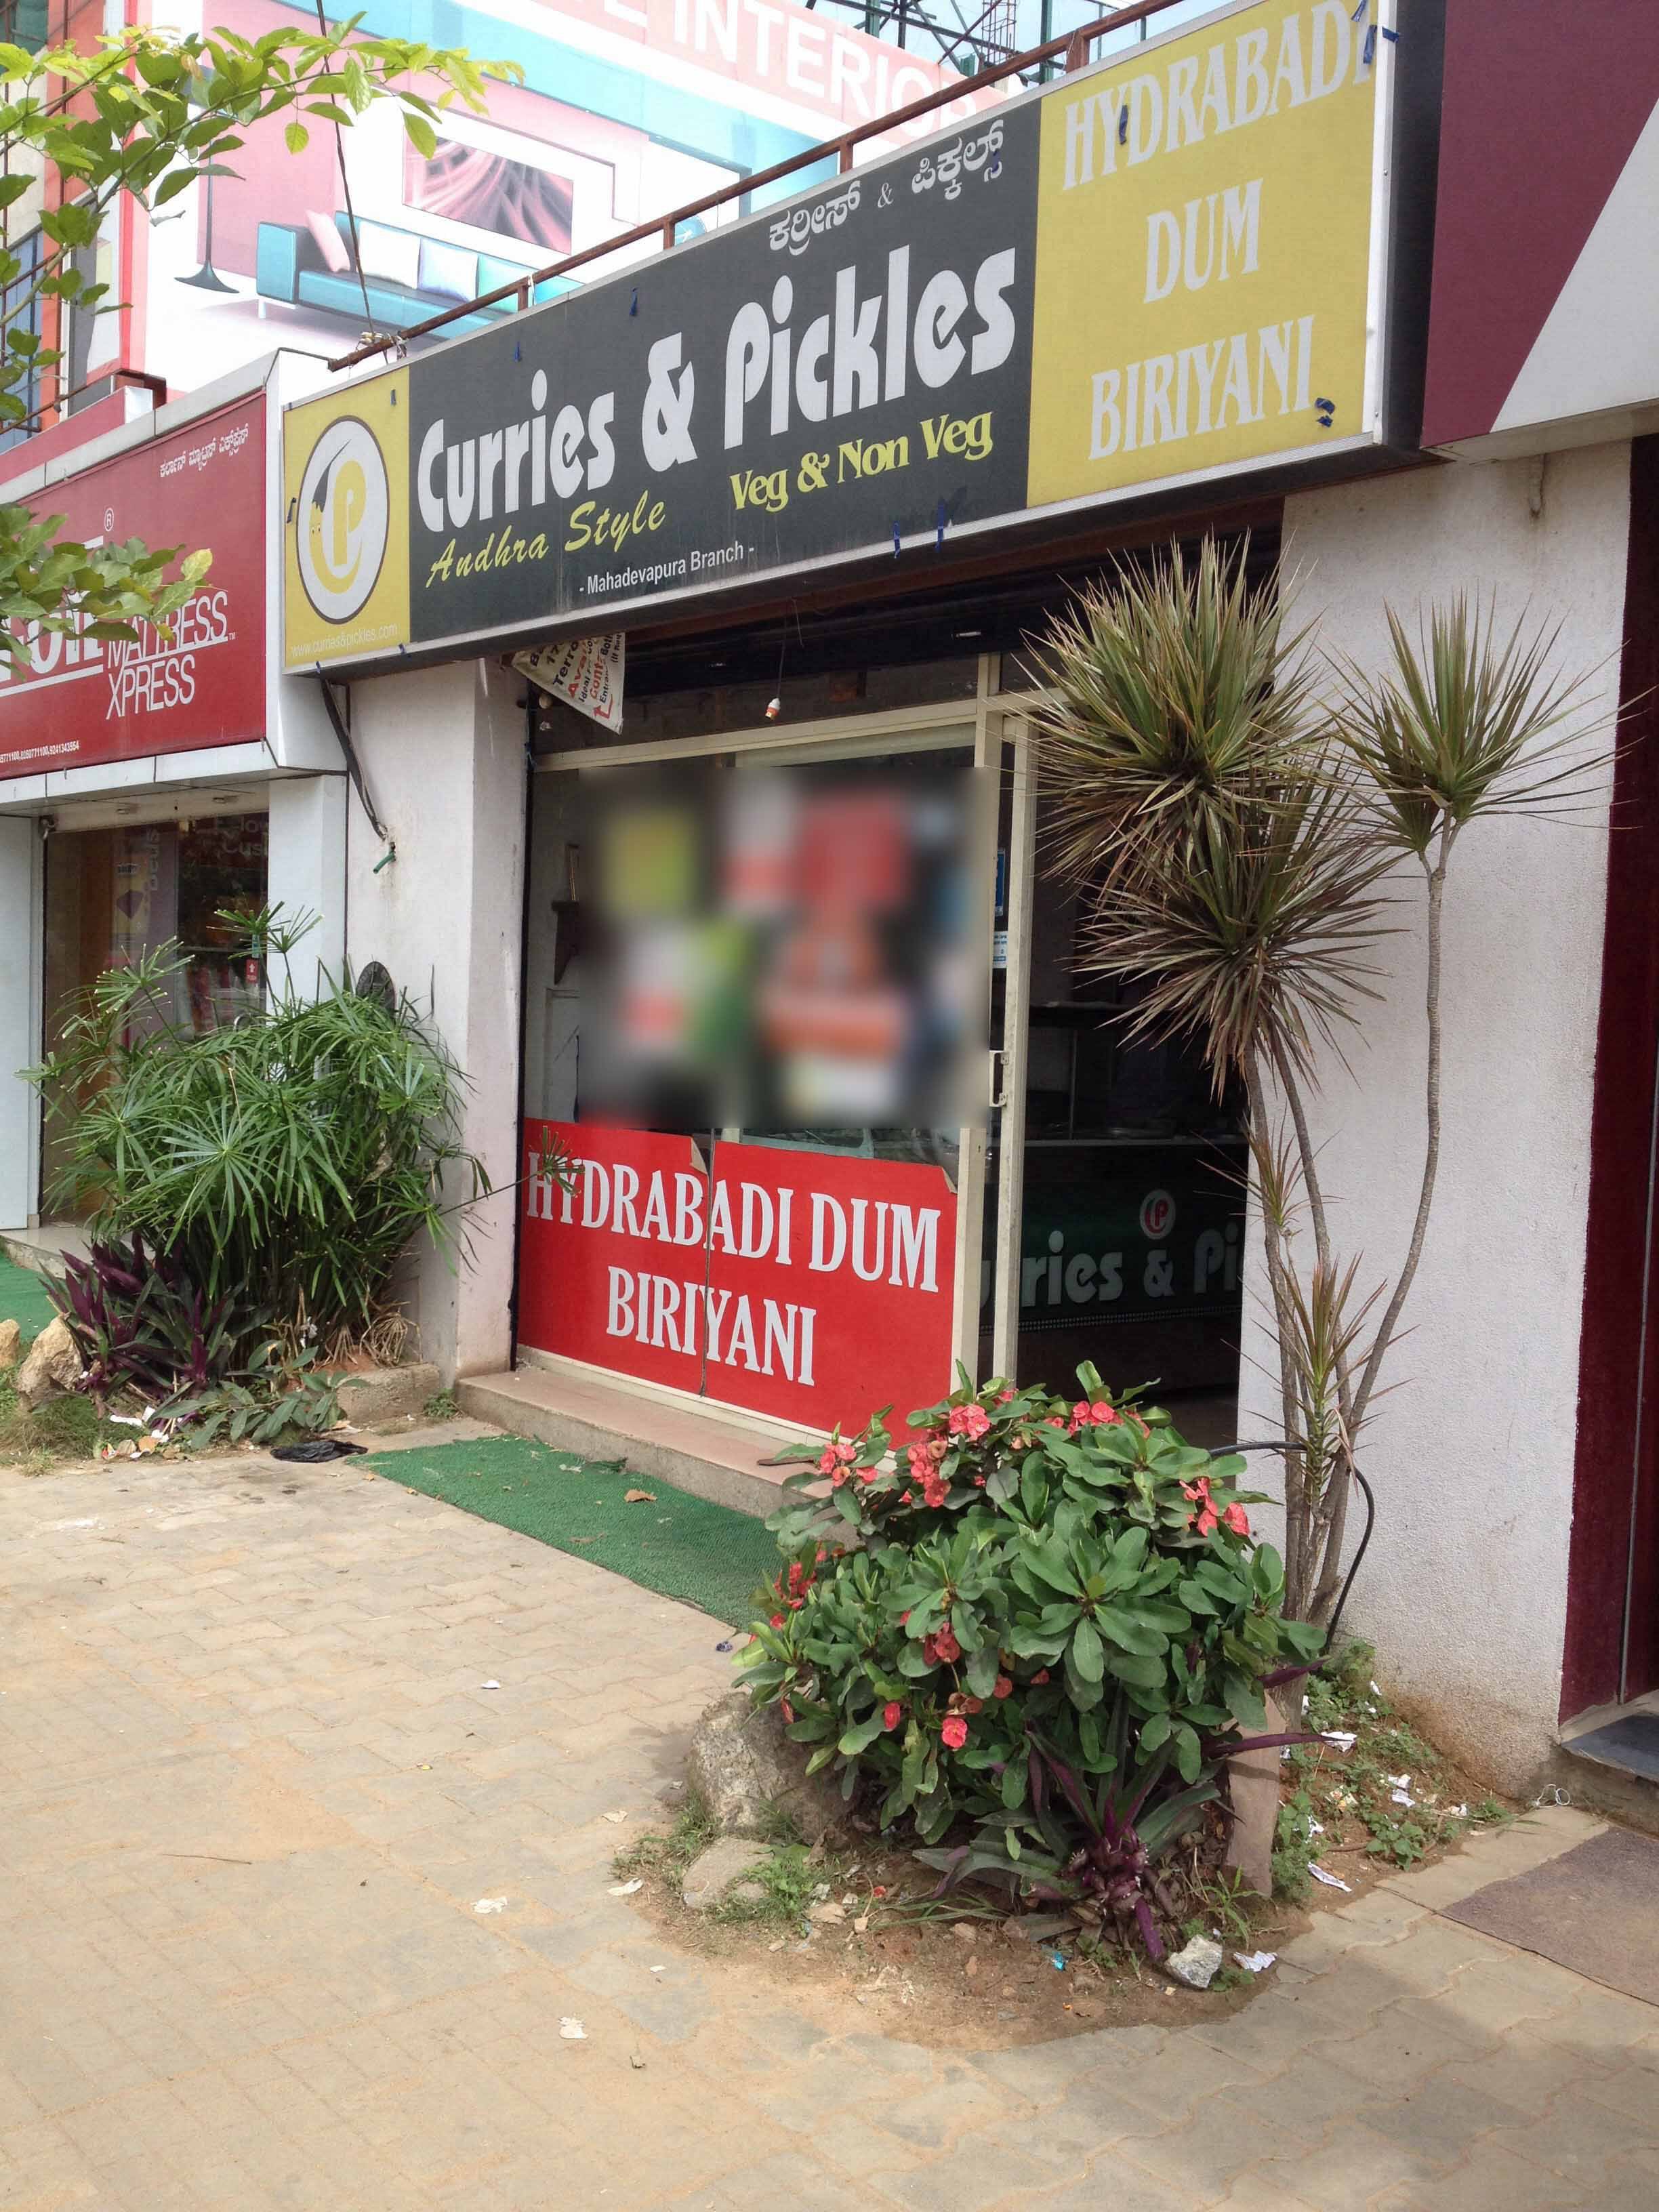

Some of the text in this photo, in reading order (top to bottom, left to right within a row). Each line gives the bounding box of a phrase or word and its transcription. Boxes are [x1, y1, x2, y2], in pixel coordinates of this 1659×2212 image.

[878, 182, 894, 208] &
[1143, 178, 1263, 304] DUM
[417, 244, 1015, 532] Curries & Pickles
[1088, 314, 1315, 460] BIRIYANI
[729, 411, 994, 512] Veg & Non Veg
[426, 490, 665, 588] Andhra Style
[588, 558, 686, 595] Mahadevapura
[691, 540, 744, 571] Branch
[106, 654, 195, 720] XPRESS
[527, 1151, 941, 1292] HYDRABADI DUM
[1143, 1249, 1176, 1298] &
[606, 1265, 816, 1387] BIRIYANI
